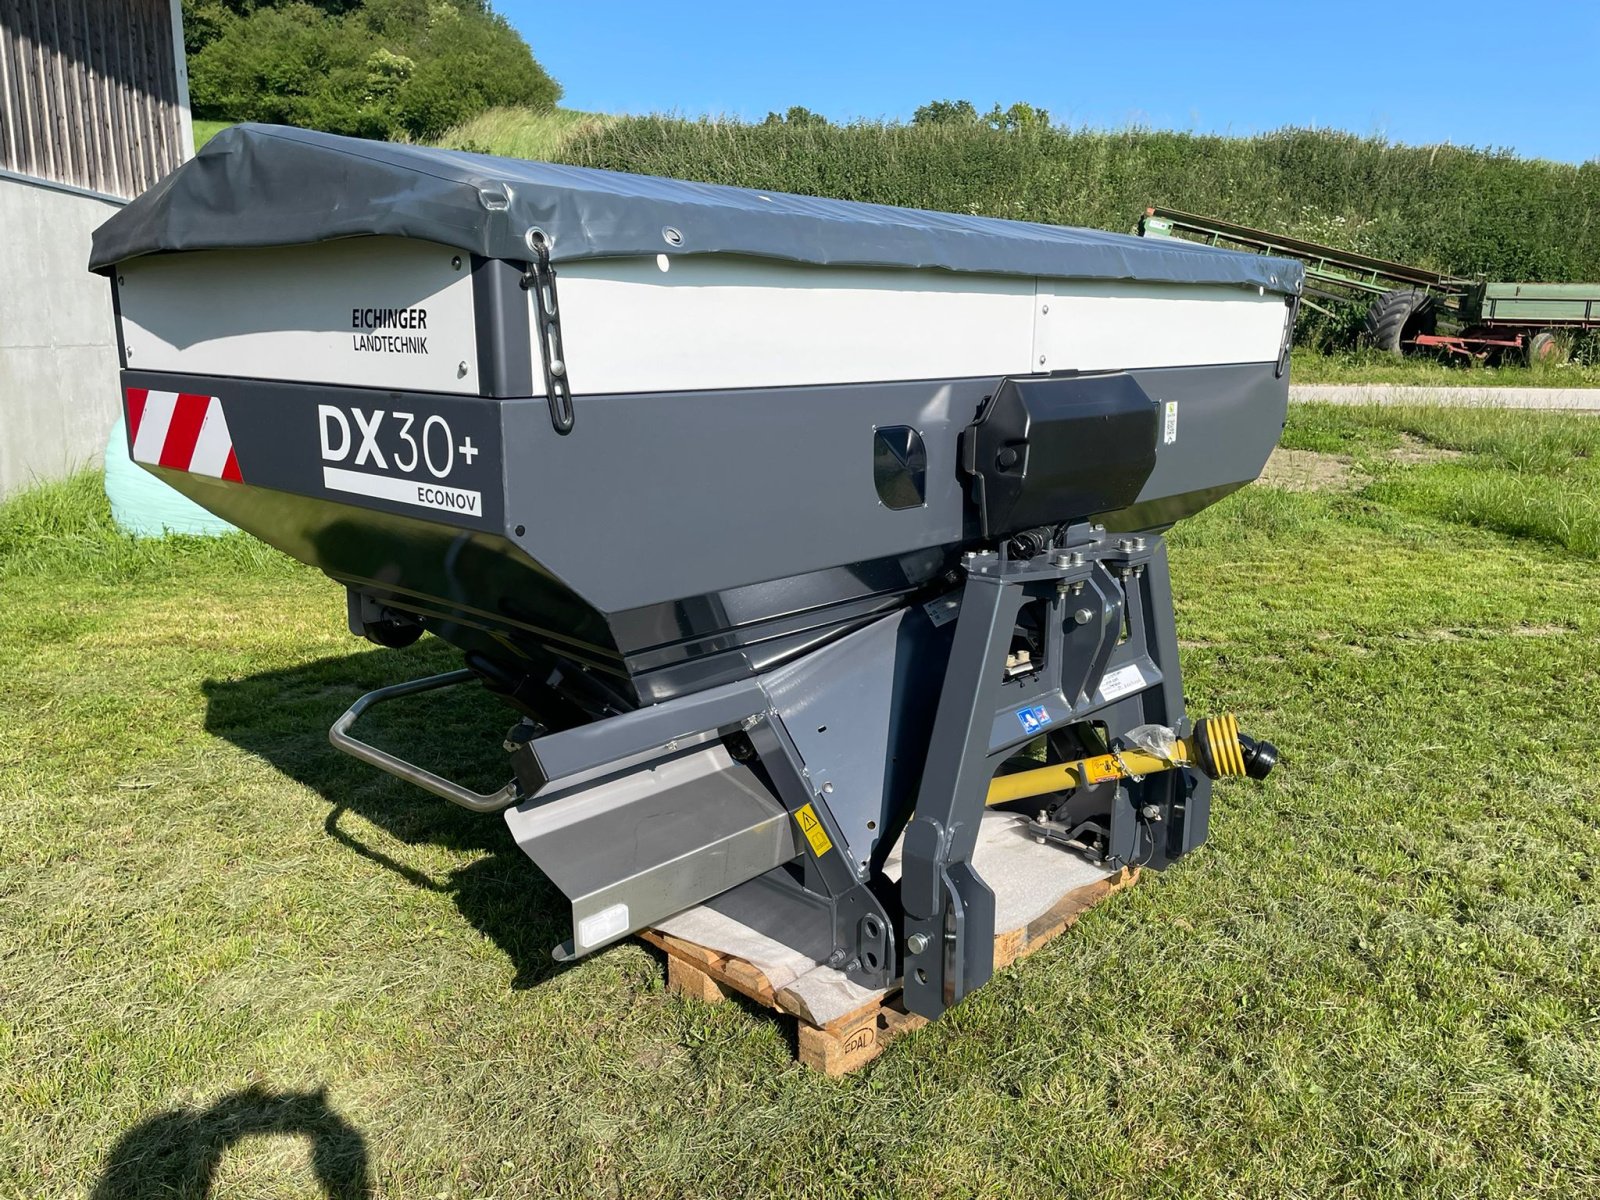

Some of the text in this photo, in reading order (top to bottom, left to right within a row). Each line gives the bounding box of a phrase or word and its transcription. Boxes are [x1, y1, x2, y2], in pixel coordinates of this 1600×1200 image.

[352, 308, 427, 330] EICHINGER
[352, 335, 429, 355] LANDTECHNIK
[317, 403, 480, 479] DX30+
[417, 486, 477, 511] ECONOV
[844, 1032, 869, 1056] EPAL
